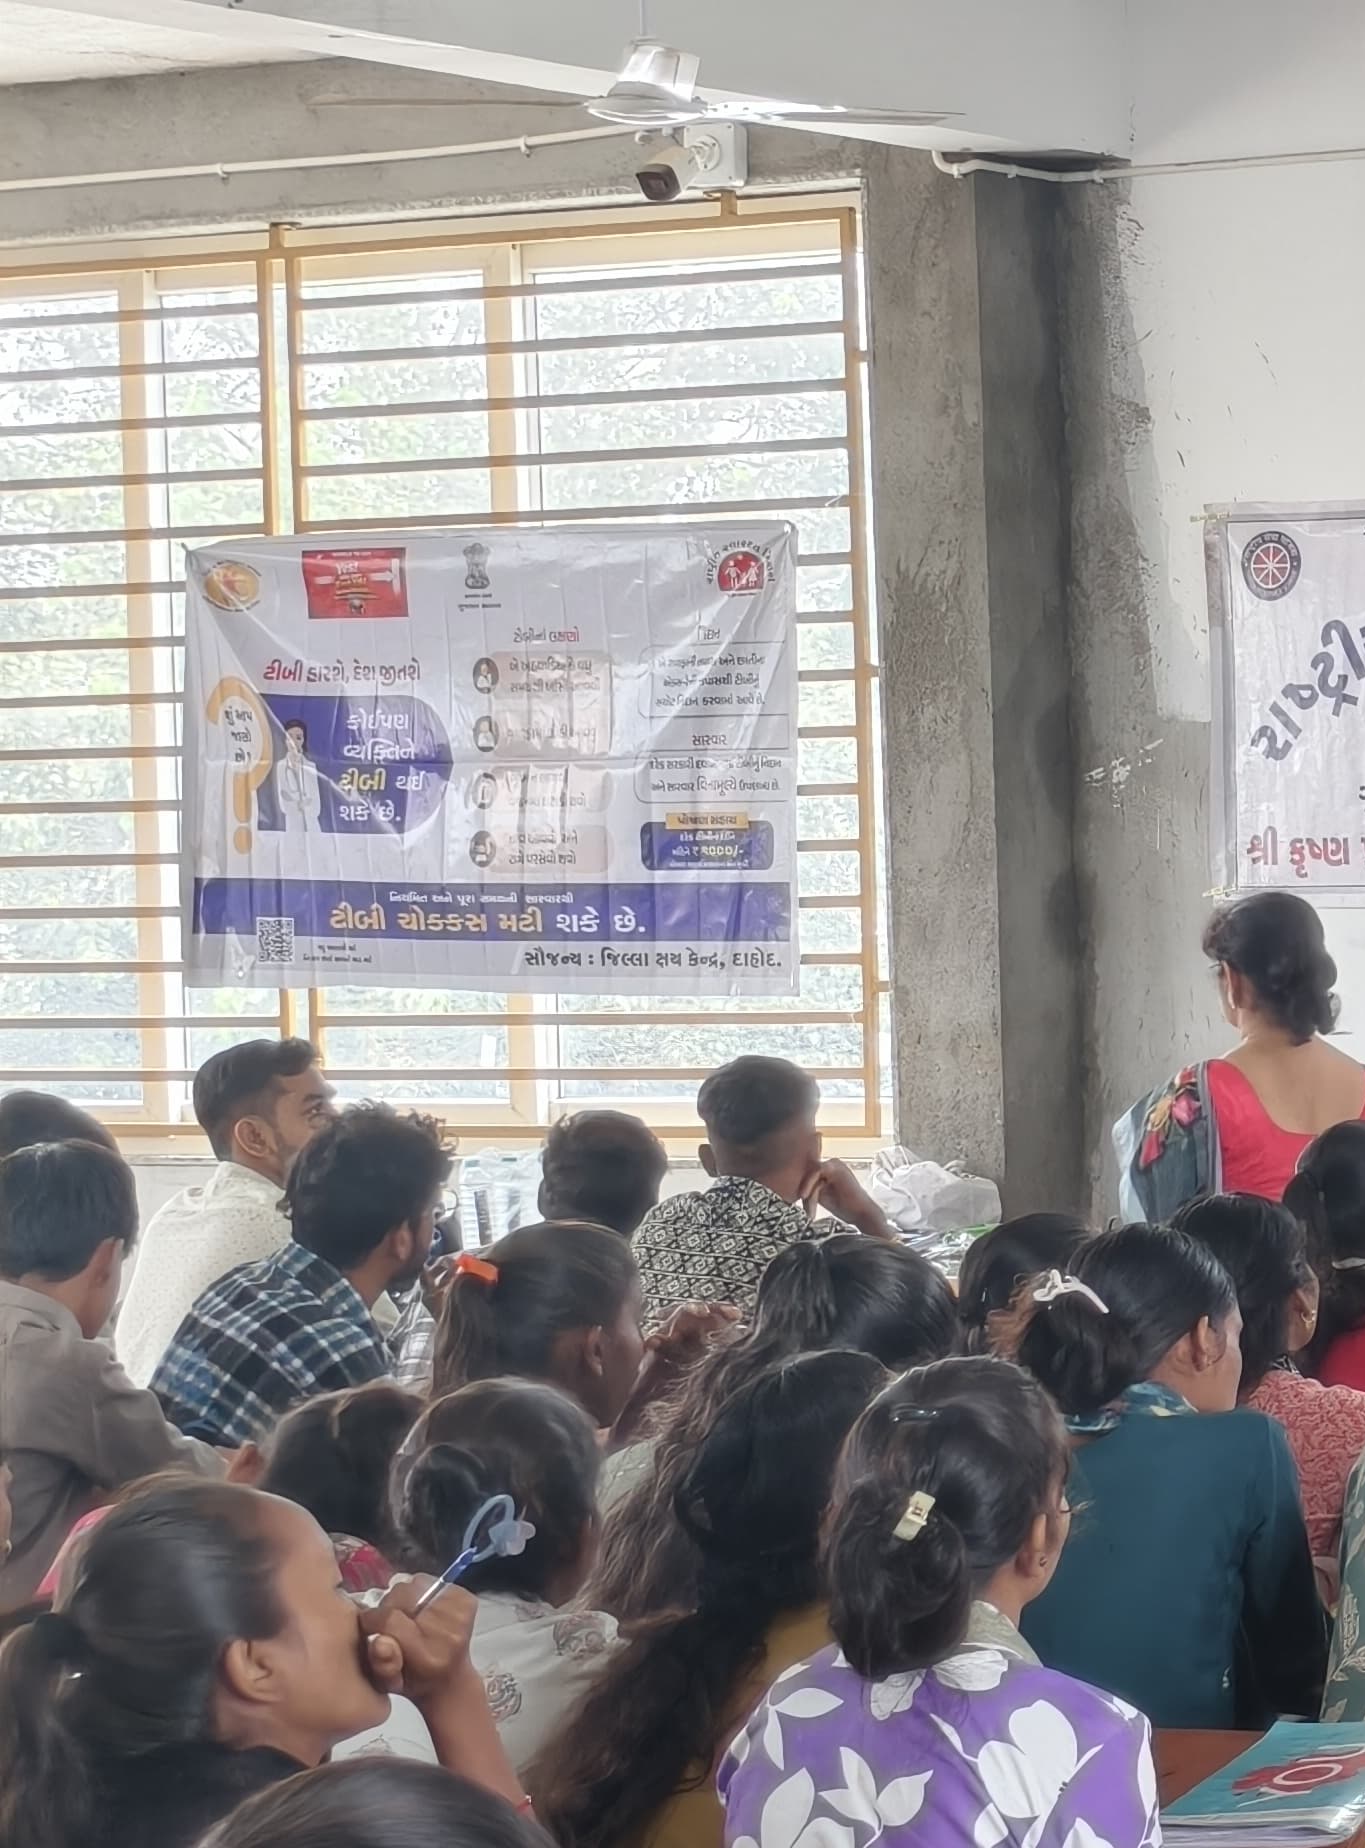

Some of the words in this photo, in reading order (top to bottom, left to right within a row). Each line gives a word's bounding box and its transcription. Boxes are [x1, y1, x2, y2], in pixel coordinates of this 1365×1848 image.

[263, 659, 304, 682] ટીબી
[346, 708, 410, 730] કોઈપણ
[338, 768, 386, 792] ટીબી
[395, 771, 425, 791] થઈ
[339, 803, 370, 822] શકે
[378, 800, 401, 822] છે.
[1246, 825, 1279, 866] શ્રી
[1288, 836, 1350, 879] કૃષ્ણ
[329, 901, 386, 930] ટીબી
[397, 905, 488, 932] ચોક્કસ
[497, 907, 544, 932] મટી
[555, 906, 600, 933] શકે
[613, 906, 647, 933] છે.
[524, 948, 582, 967] સૌજન્ય
[601, 947, 650, 967] જિલ્લા
[655, 952, 682, 968] ક્ષય
[732, 948, 782, 968] દાહોદ.
